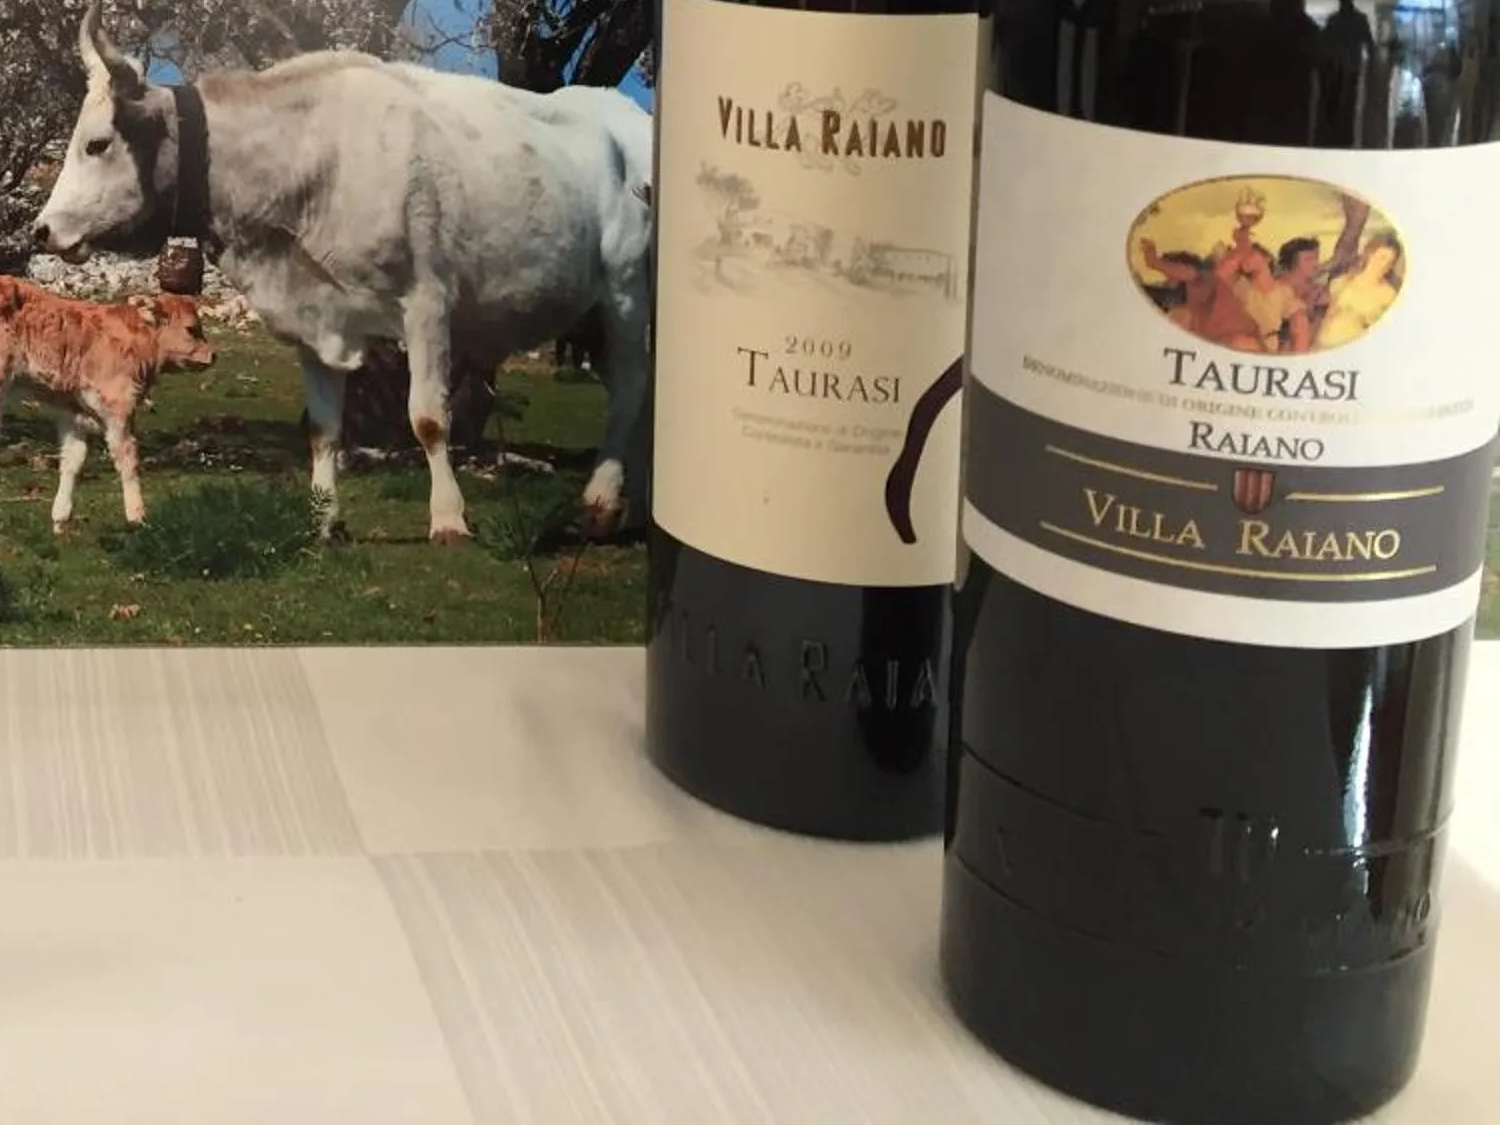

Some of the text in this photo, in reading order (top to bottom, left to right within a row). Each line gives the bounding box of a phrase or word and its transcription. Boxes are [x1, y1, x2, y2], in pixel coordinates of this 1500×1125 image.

[717, 95, 947, 158] VILLA RAIANO
[736, 346, 900, 404] TAURASI
[785, 335, 852, 359] 2009
[1162, 346, 1360, 402] TAURASI
[1188, 420, 1325, 461] RAIANO
[1081, 487, 1401, 562] VILLA RAIANO
